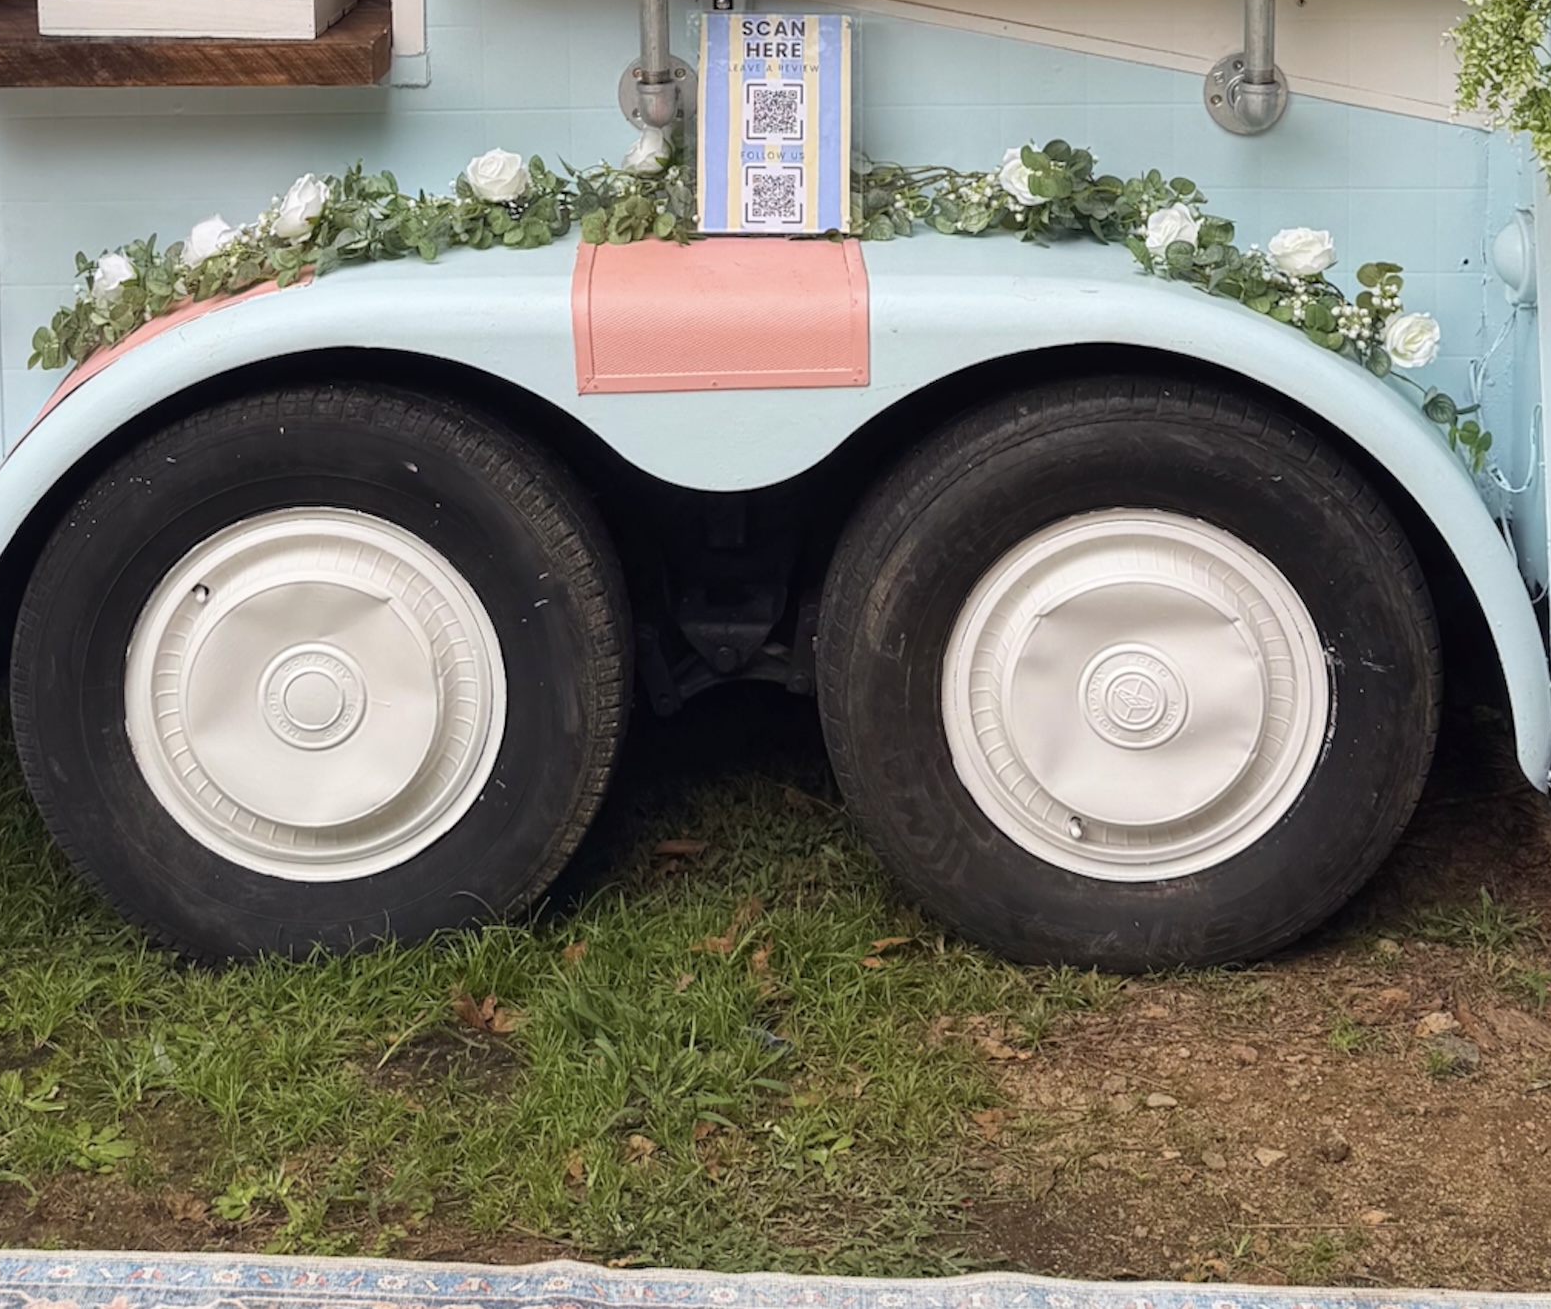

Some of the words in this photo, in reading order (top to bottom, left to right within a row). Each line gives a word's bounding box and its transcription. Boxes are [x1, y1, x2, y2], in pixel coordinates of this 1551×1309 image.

[741, 20, 806, 37] SCAN
[746, 41, 802, 59] HERE
[728, 63, 761, 73] LEAVE
[765, 63, 773, 73] A
[778, 63, 820, 73] REVIEW
[740, 151, 785, 161] FOLLOW
[790, 151, 805, 161] US
[281, 654, 352, 681] COMPANY
